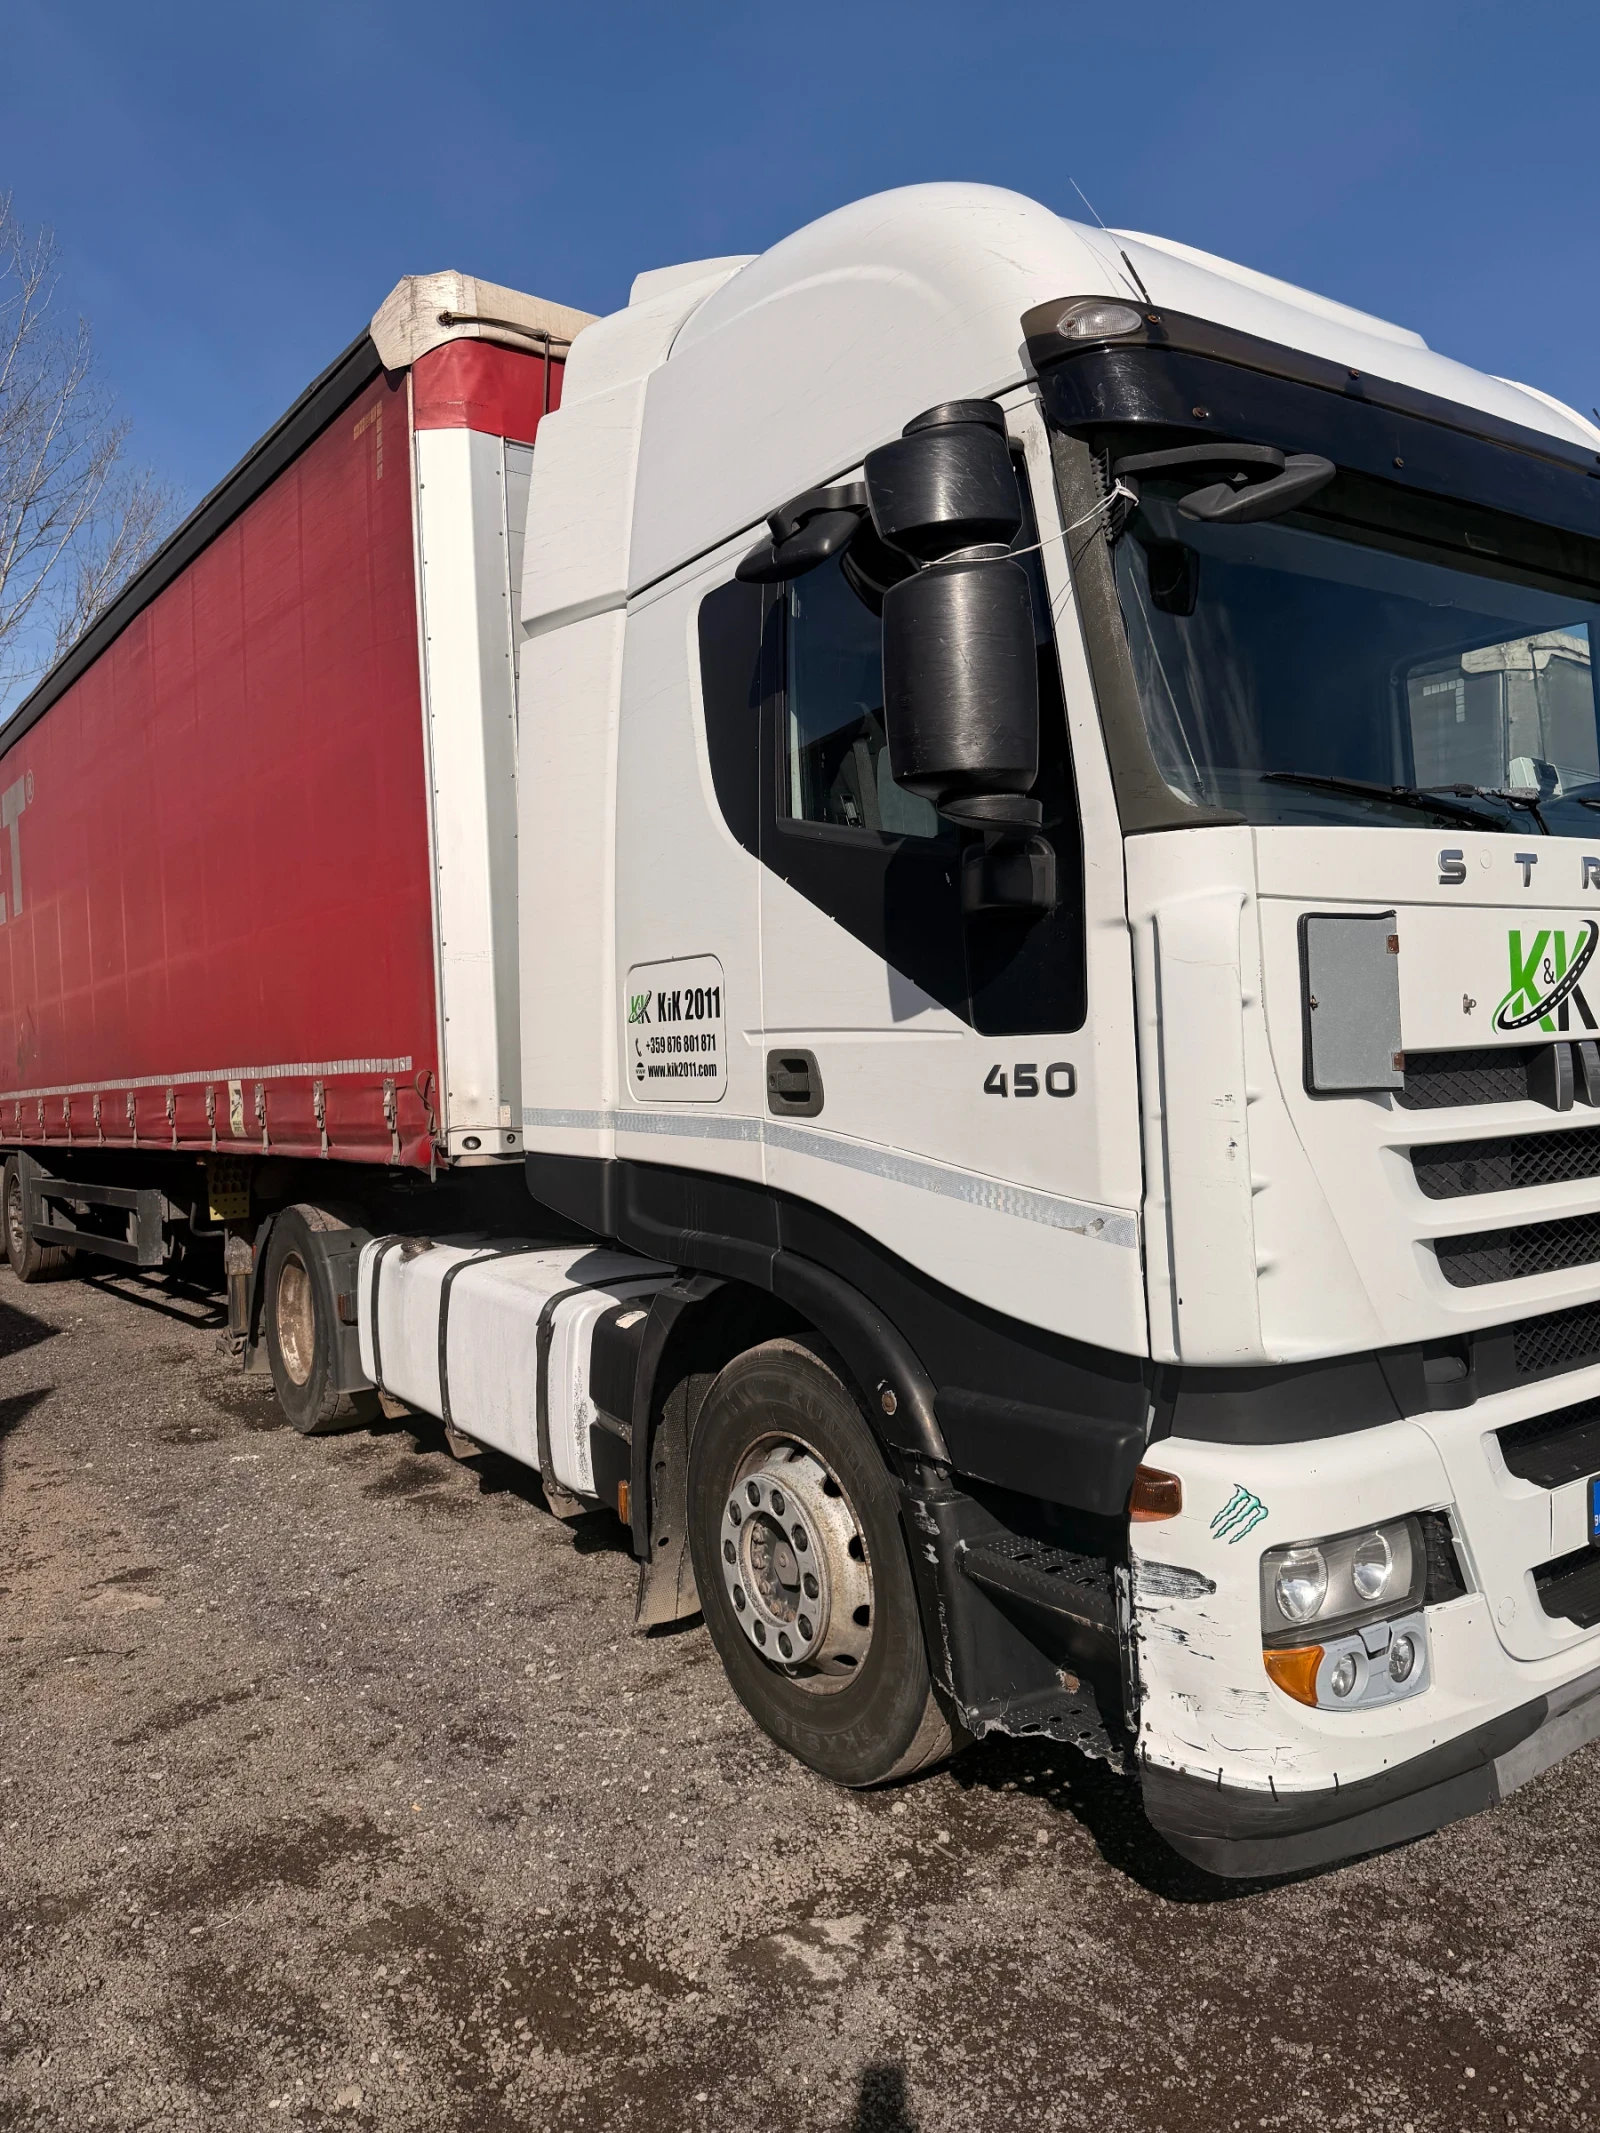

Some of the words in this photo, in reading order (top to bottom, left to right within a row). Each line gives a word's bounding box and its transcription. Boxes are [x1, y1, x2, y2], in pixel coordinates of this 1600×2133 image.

[657, 990, 682, 1023] KiK
[684, 985, 721, 1021] 2011
[645, 1036, 666, 1054] +359
[667, 1035, 682, 1053] 876
[683, 1034, 700, 1052] 801
[701, 1033, 716, 1051] 871
[647, 1061, 718, 1078] www.kik2011.com
[983, 1062, 1078, 1098] 450
